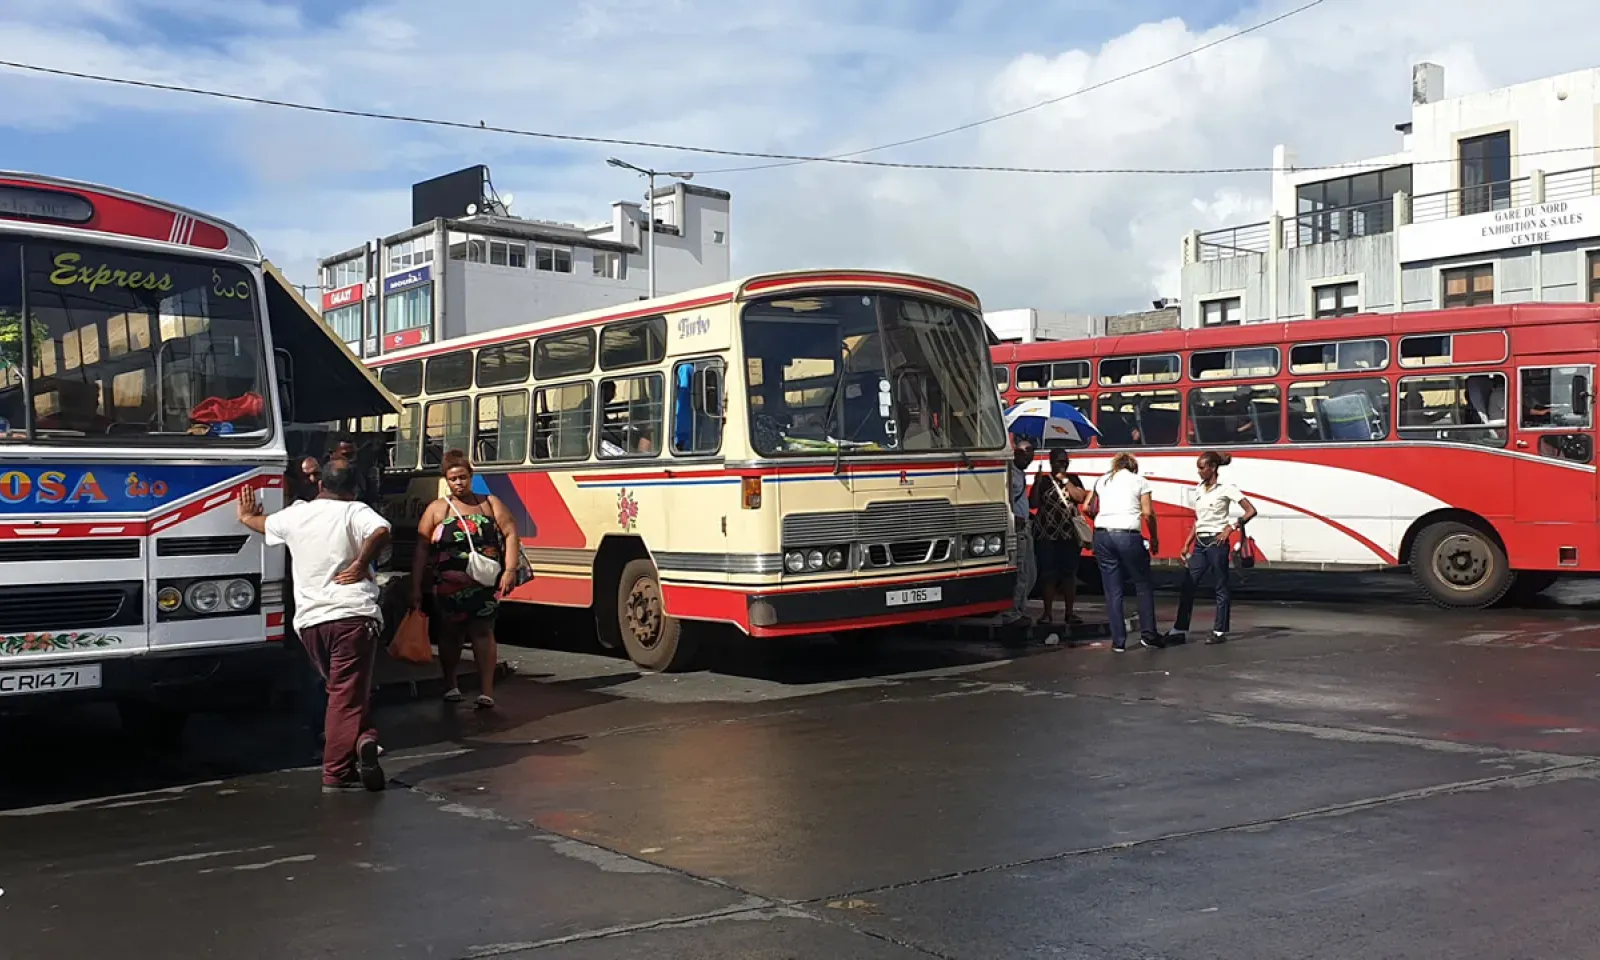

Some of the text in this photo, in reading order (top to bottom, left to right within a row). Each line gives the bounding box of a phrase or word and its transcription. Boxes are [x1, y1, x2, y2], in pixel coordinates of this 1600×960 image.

[1495, 202, 1568, 222] GARE DU NORD
[1481, 213, 1583, 237] EXHIBITION & SALES
[1511, 230, 1550, 245] CENTRE
[50, 252, 174, 292] Express
[911, 589, 927, 602] 765
